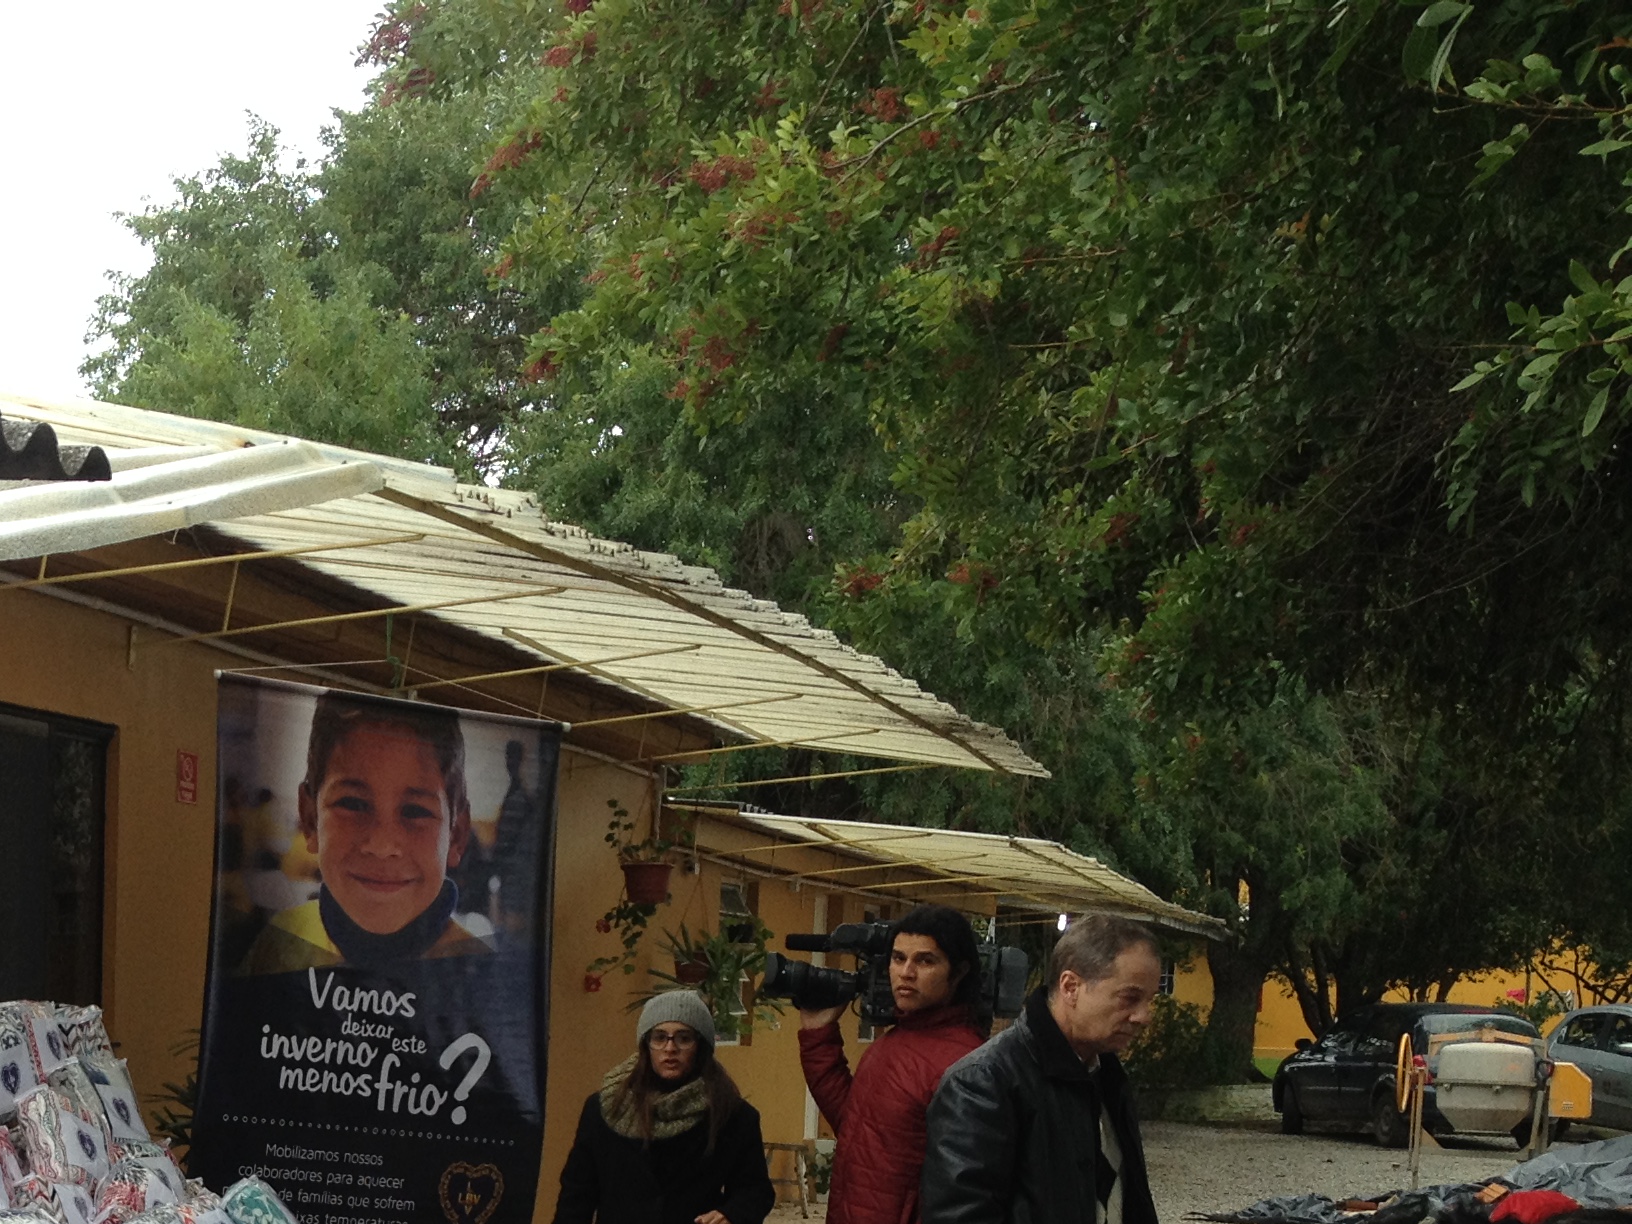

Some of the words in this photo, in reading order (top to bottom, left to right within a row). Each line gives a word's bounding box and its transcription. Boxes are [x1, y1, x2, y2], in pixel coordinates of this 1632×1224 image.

[308, 966, 417, 1018] Vamos
[260, 1023, 379, 1068] inverno
[341, 1012, 395, 1039] deixar
[391, 1035, 428, 1054] este
[279, 1065, 373, 1098] menos
[265, 1143, 340, 1163] Mobilizamos
[343, 1152, 384, 1167] nossos
[238, 1163, 323, 1184] colaboradores
[326, 1171, 353, 1186] para
[356, 1174, 405, 1190] aquecer
[347, 1195, 370, 1209] que
[374, 1198, 416, 1212] sofrem
